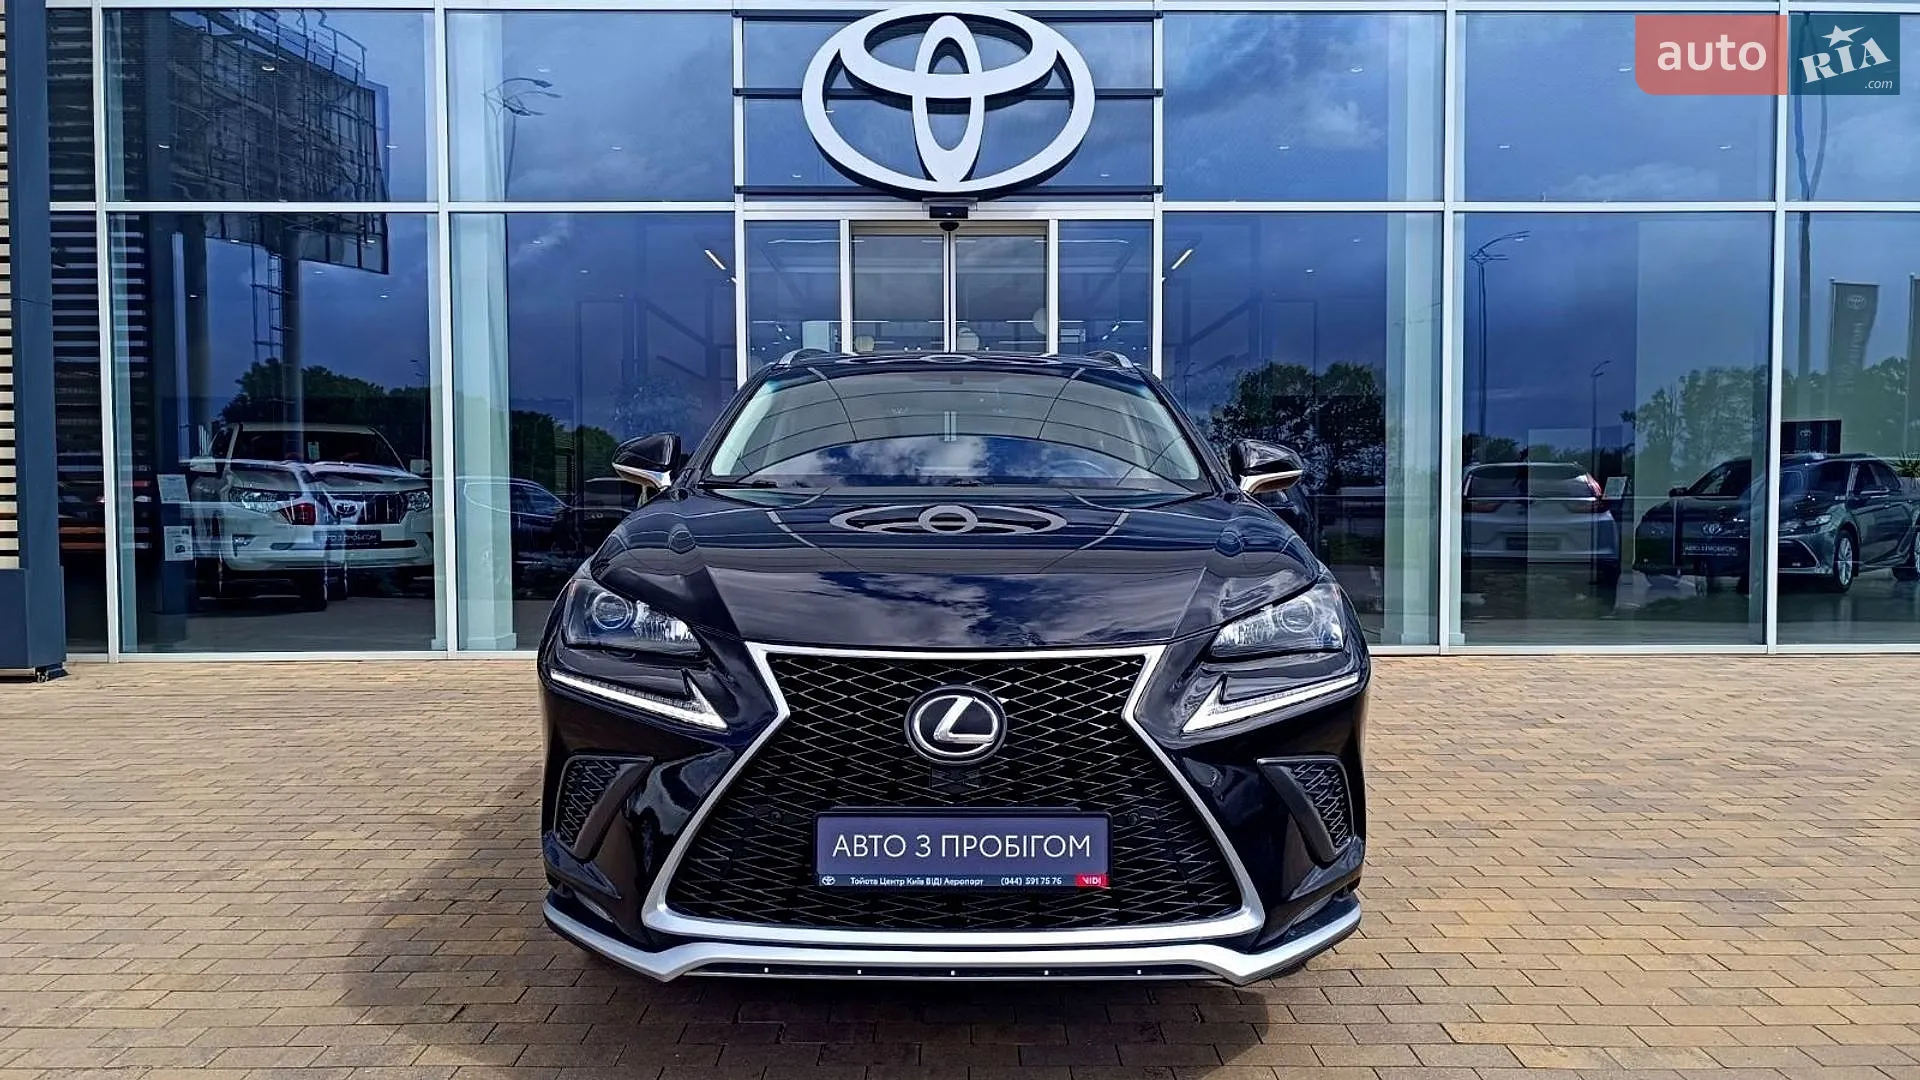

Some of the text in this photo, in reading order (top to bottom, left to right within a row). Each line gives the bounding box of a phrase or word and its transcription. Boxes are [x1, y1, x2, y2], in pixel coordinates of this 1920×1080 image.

[832, 834, 906, 858] АВТО
[941, 834, 1091, 858] ПРОБІГОМ
[850, 876, 878, 886] Тойота
[879, 876, 905, 887] Центр
[943, 876, 983, 887] Аеропорт
[1000, 876, 1022, 886] (044)
[1025, 876, 1039, 886] 591
[1040, 876, 1050, 886] 75
